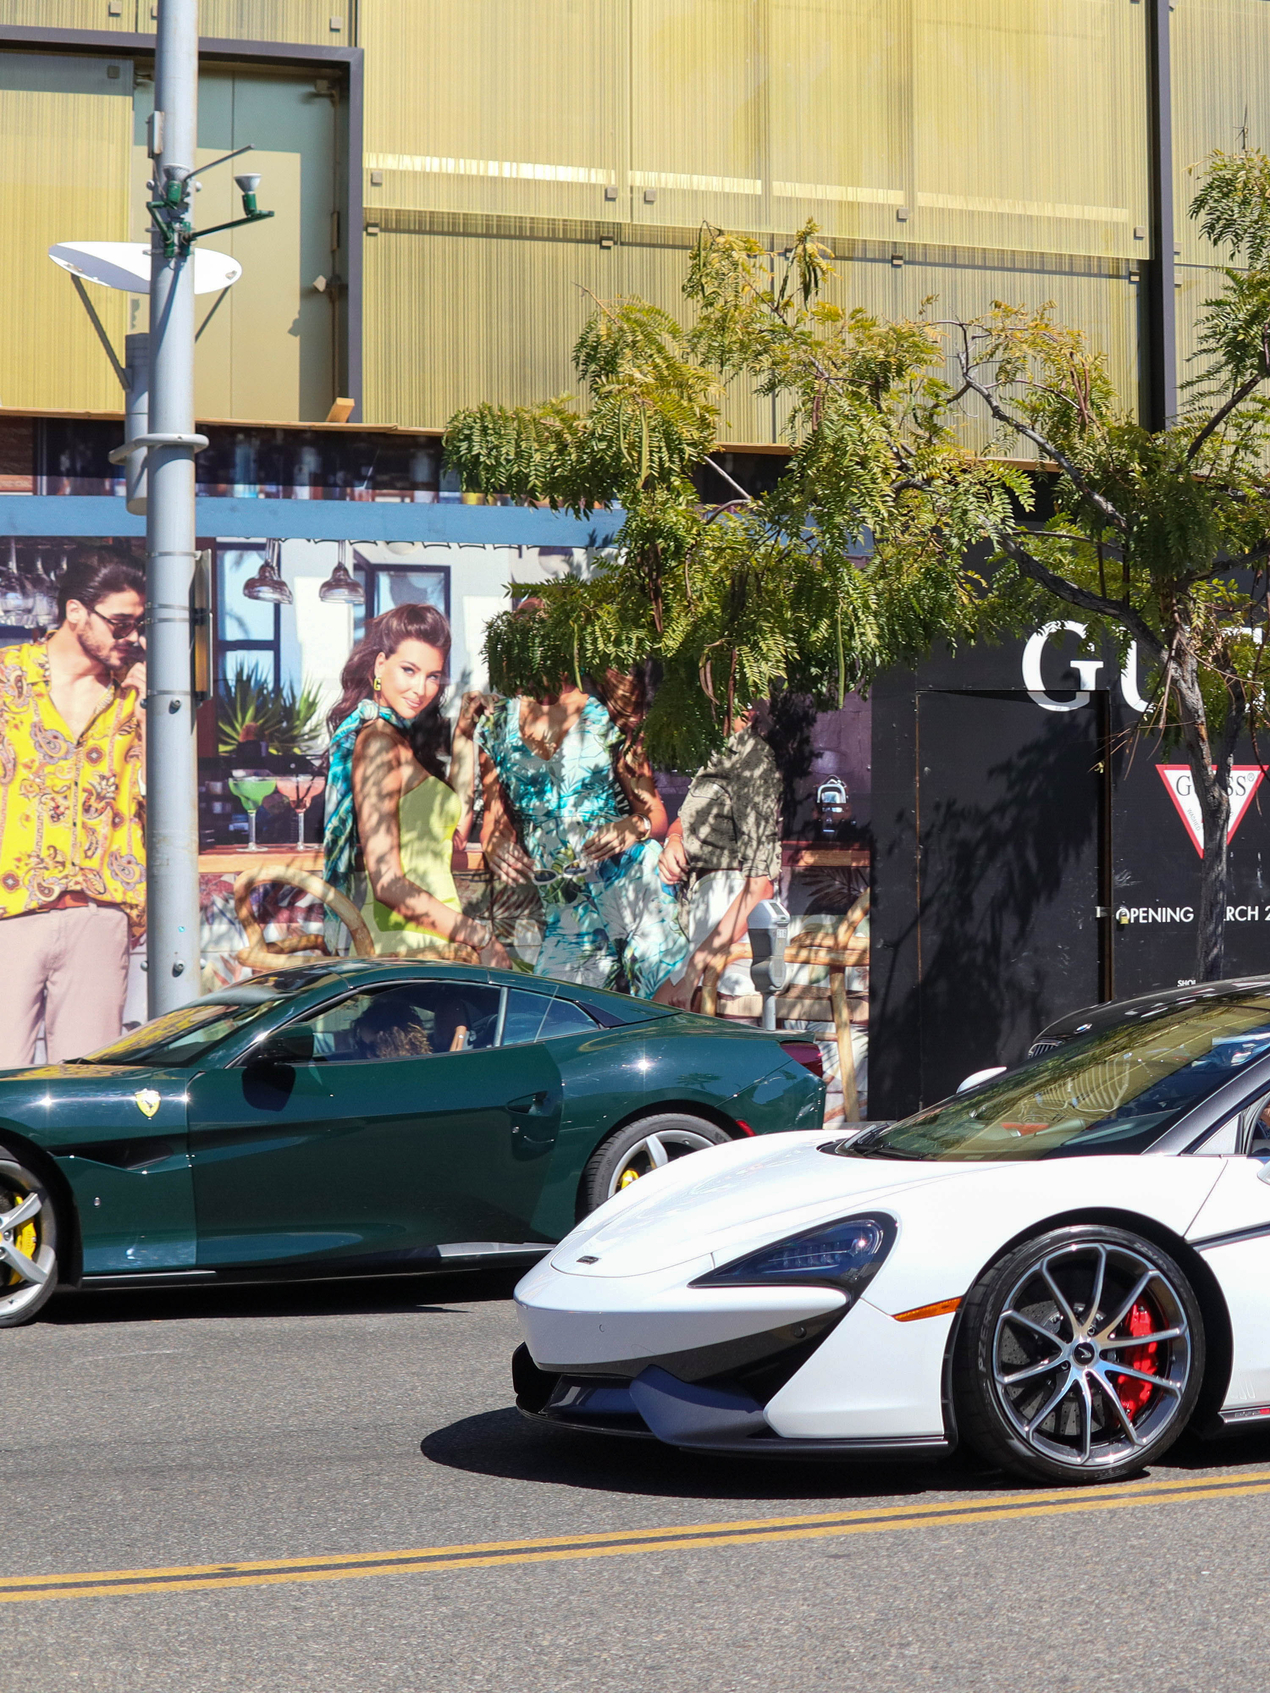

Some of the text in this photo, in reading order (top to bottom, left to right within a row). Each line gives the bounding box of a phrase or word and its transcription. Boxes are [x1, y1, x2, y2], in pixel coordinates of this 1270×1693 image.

[1175, 775, 1247, 797] GSS
[1115, 906, 1194, 923] OPENING
[1223, 905, 1259, 921] RCH
